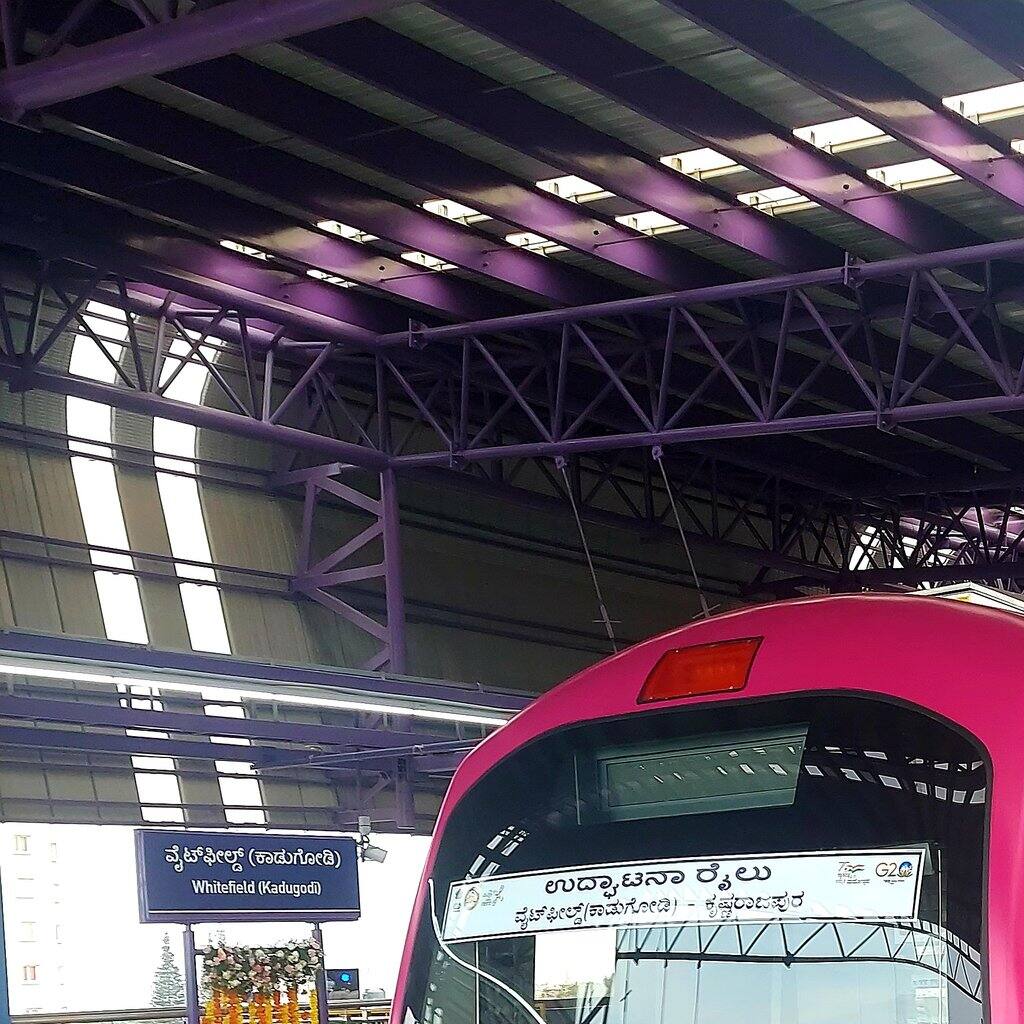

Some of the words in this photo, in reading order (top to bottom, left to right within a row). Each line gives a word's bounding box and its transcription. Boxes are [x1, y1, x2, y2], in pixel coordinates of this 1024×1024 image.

[249, 848, 341, 868] (ಕಾಡುಗೋಡಿ)
[696, 862, 772, 892] ರೈಲು
[192, 879, 256, 894] Whitefield
[258, 881, 322, 897] (Kadugodi)
